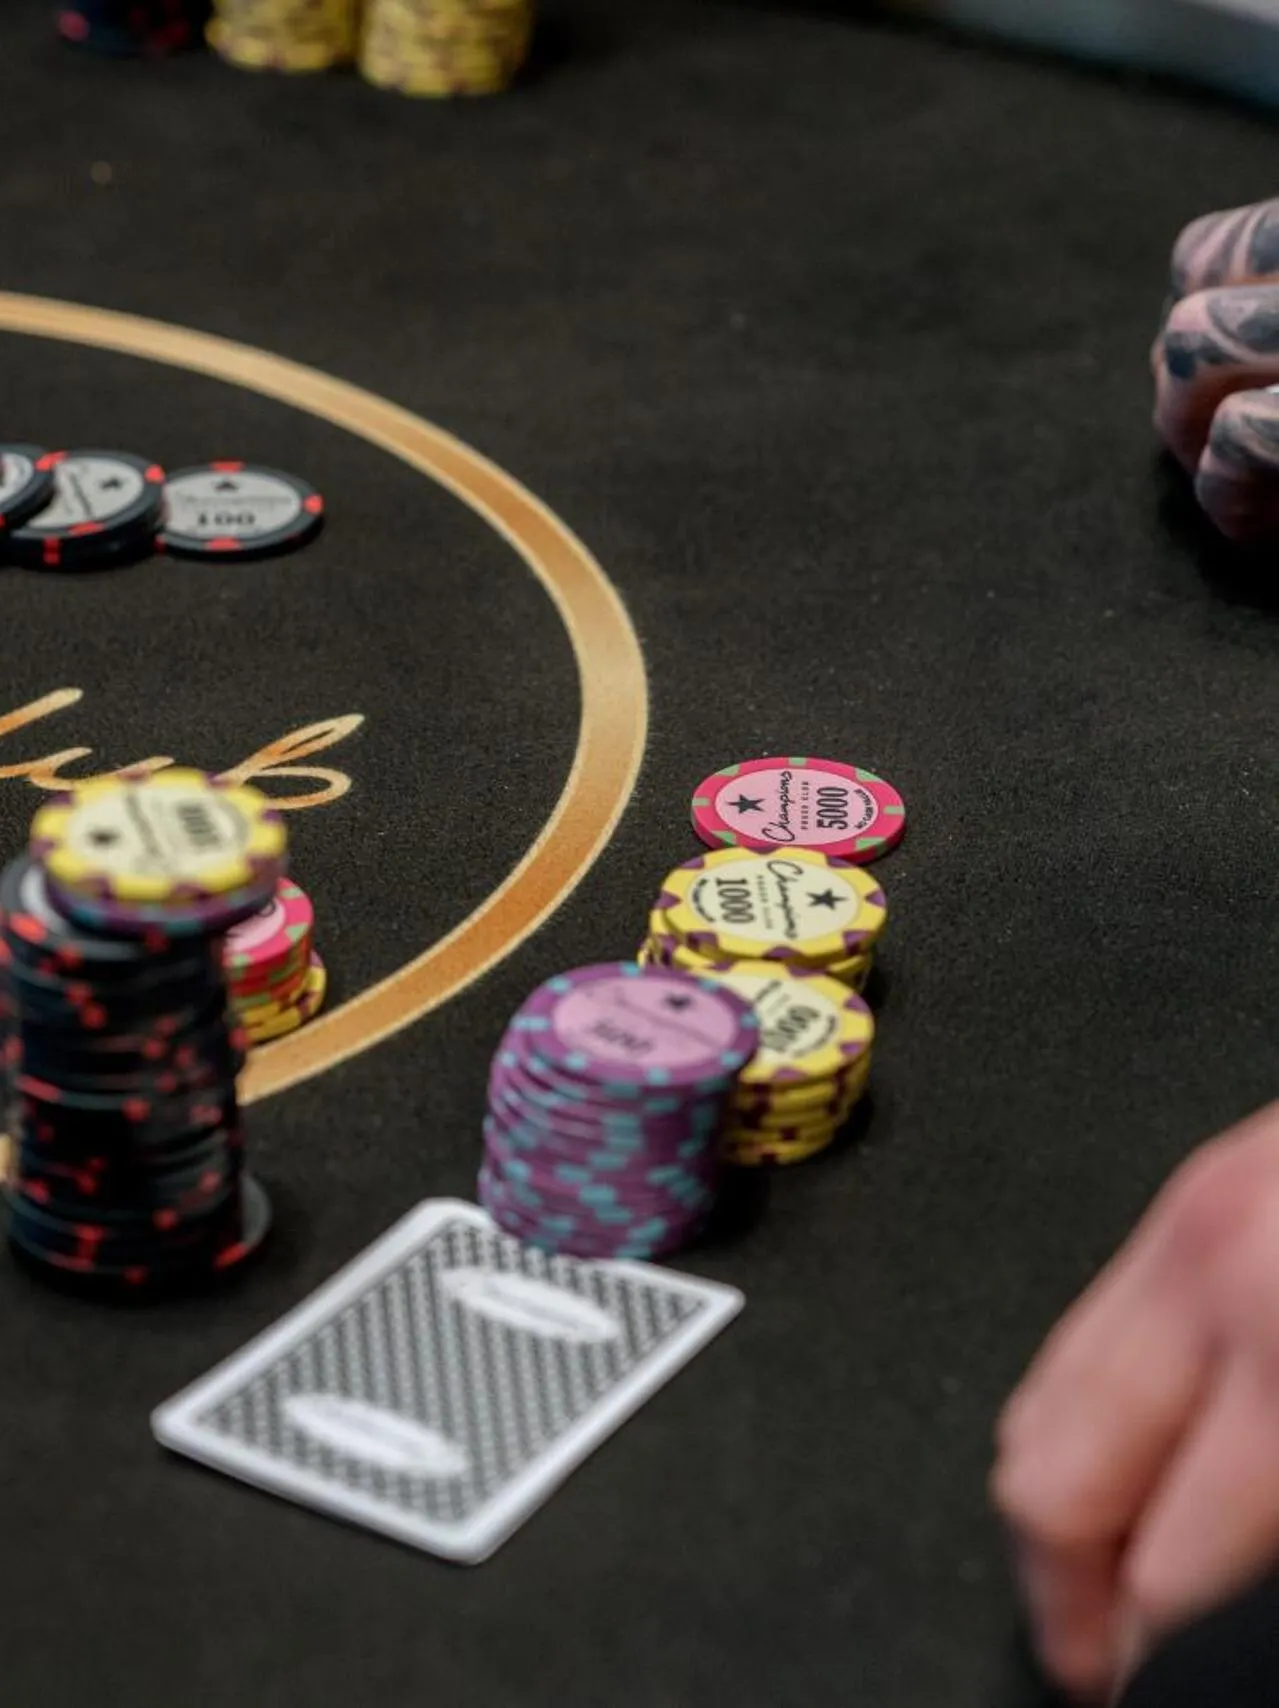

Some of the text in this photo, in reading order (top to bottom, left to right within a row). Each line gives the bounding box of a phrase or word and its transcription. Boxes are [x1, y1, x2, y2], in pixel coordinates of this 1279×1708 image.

[761, 770, 796, 843] Champions
[816, 786, 848, 830] 5000
[715, 877, 755, 924] 1000
